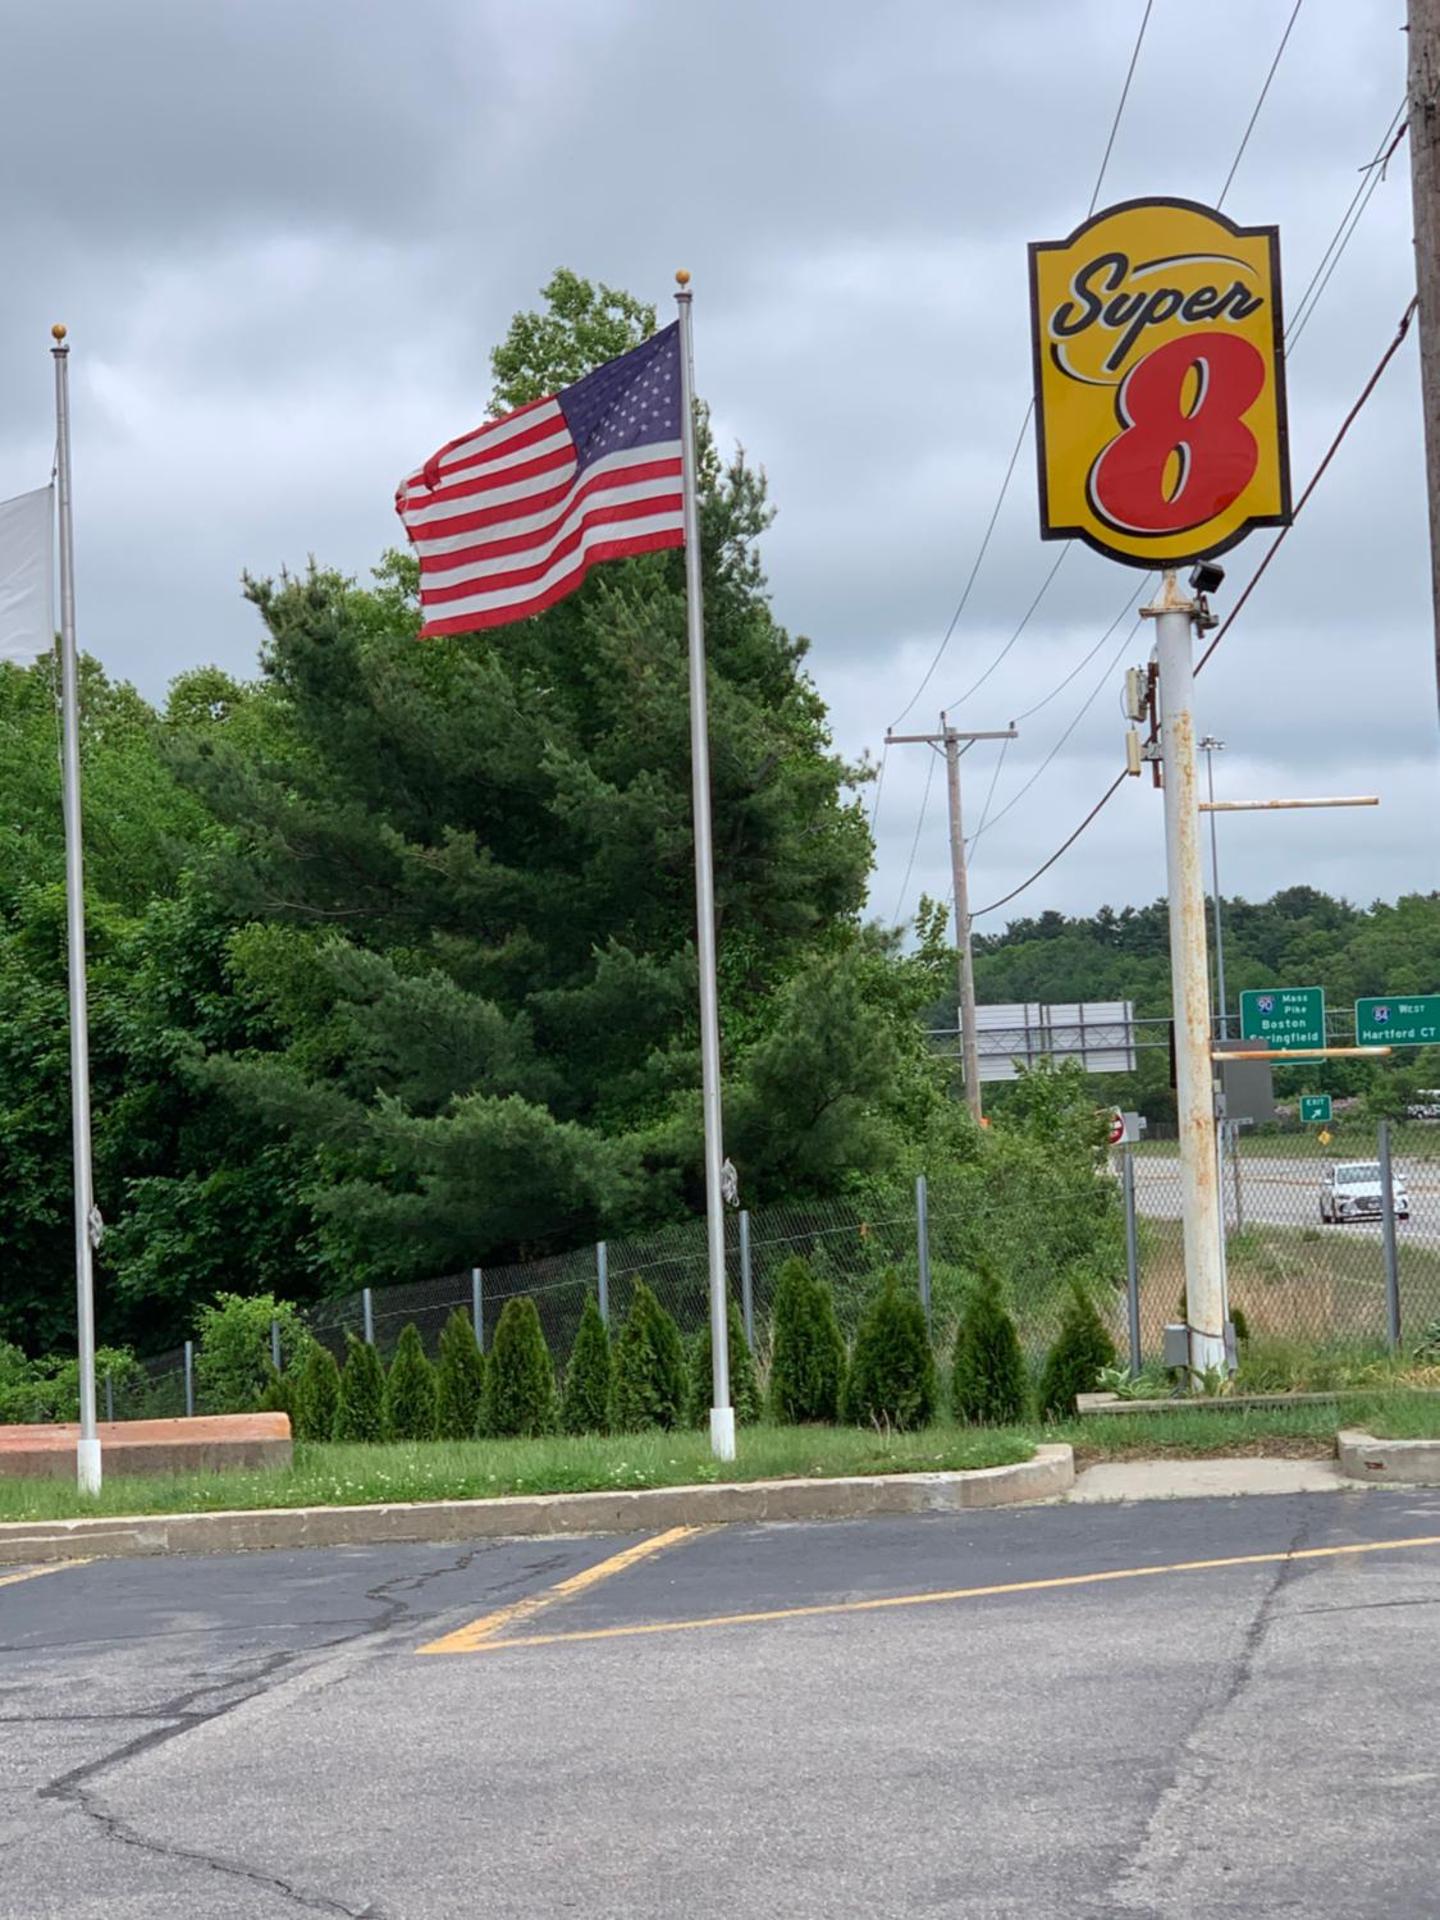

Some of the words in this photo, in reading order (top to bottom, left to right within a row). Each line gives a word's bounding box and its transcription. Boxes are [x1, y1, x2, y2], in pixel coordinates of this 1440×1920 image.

[1051, 252, 1264, 372] Super
[1085, 331, 1266, 538] 8
[1282, 995, 1308, 1003] Mass
[1284, 1006, 1307, 1014] Pike
[1261, 1020, 1307, 1030] Boston
[1362, 1028, 1416, 1040] Hartford
[1420, 1027, 1436, 1037] CT
